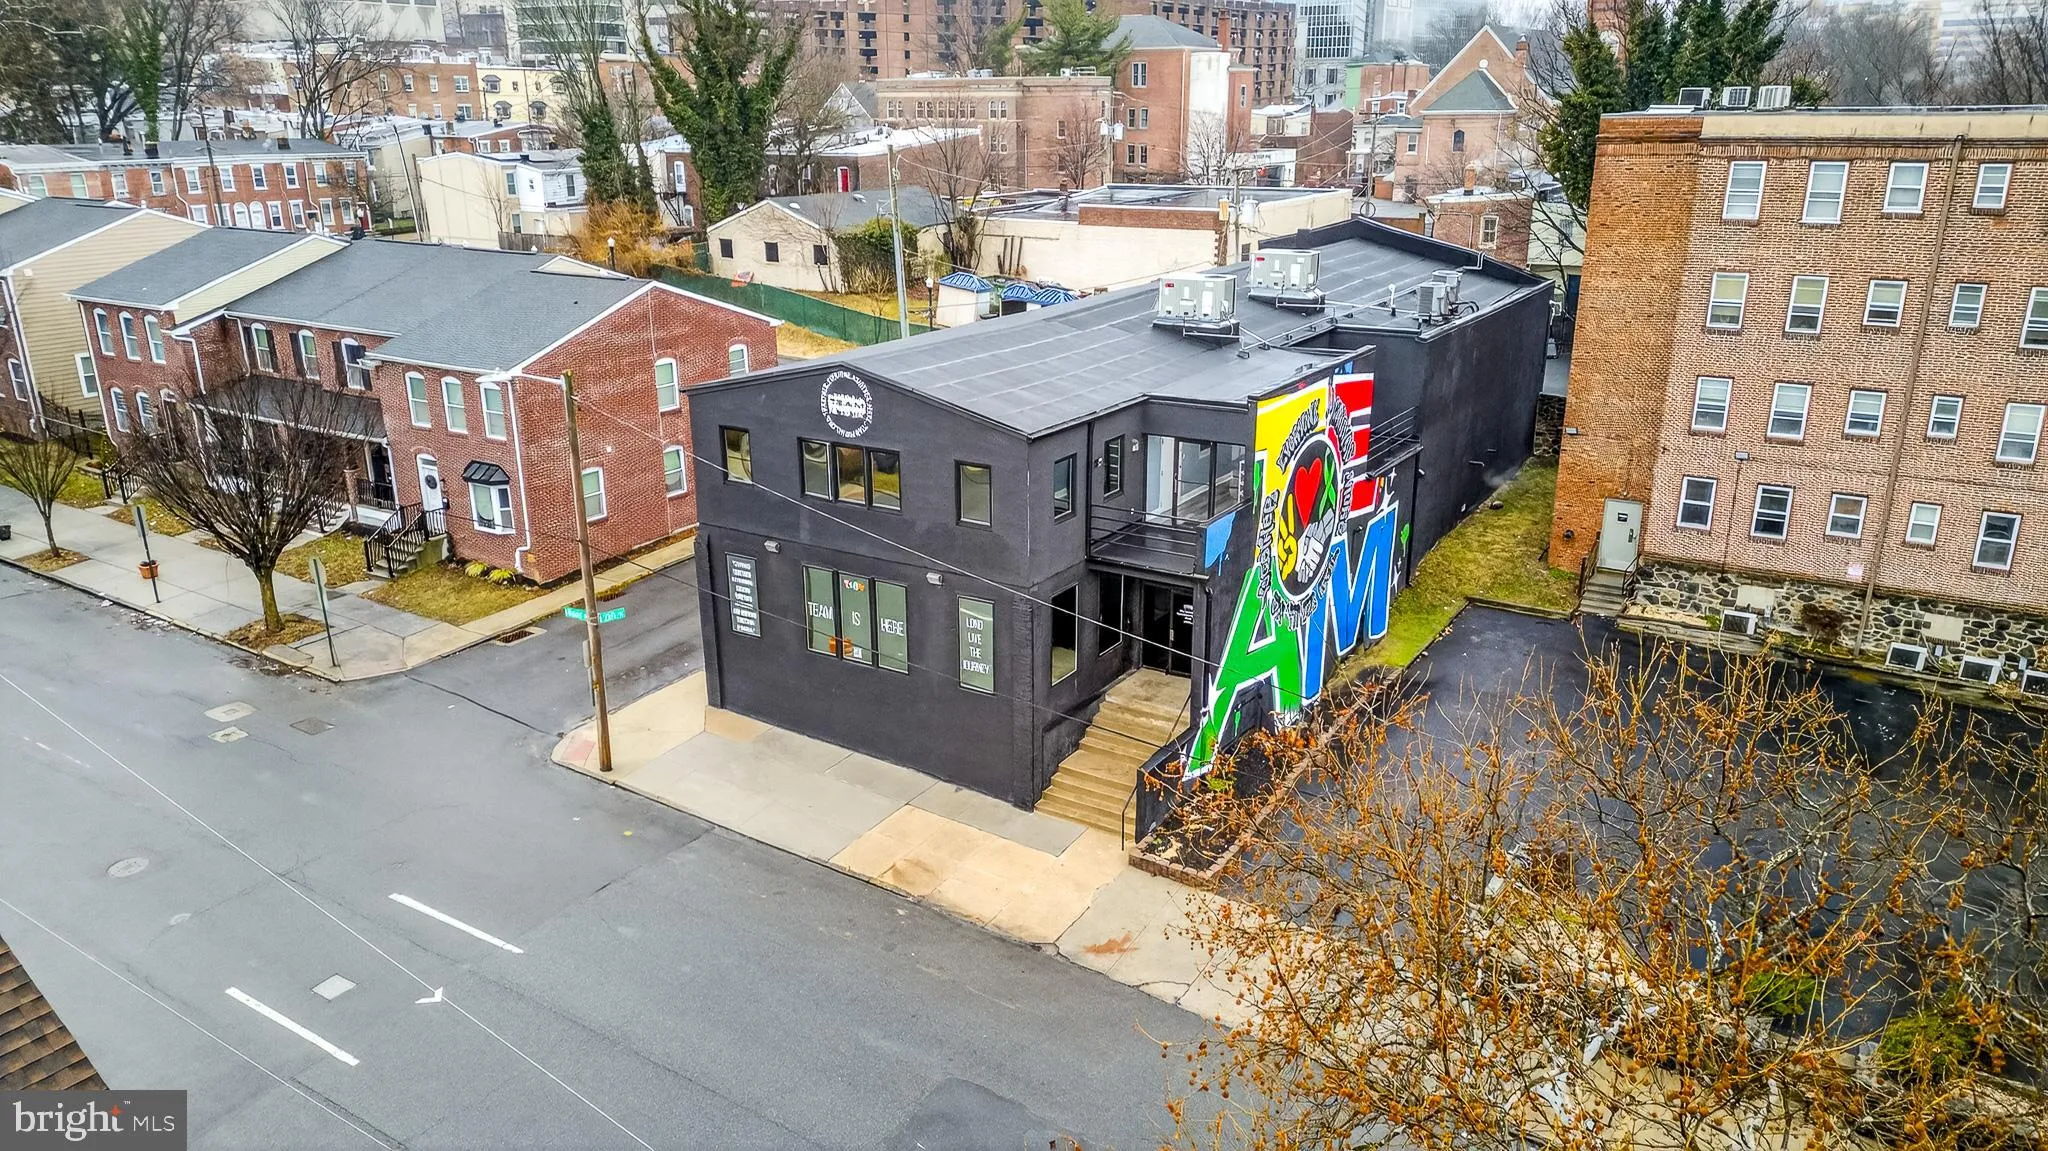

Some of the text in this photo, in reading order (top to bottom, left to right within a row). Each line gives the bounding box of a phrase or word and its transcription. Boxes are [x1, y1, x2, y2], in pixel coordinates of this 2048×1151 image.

[807, 601, 905, 637] TEAM IS HERE
[969, 646, 982, 659] THE
